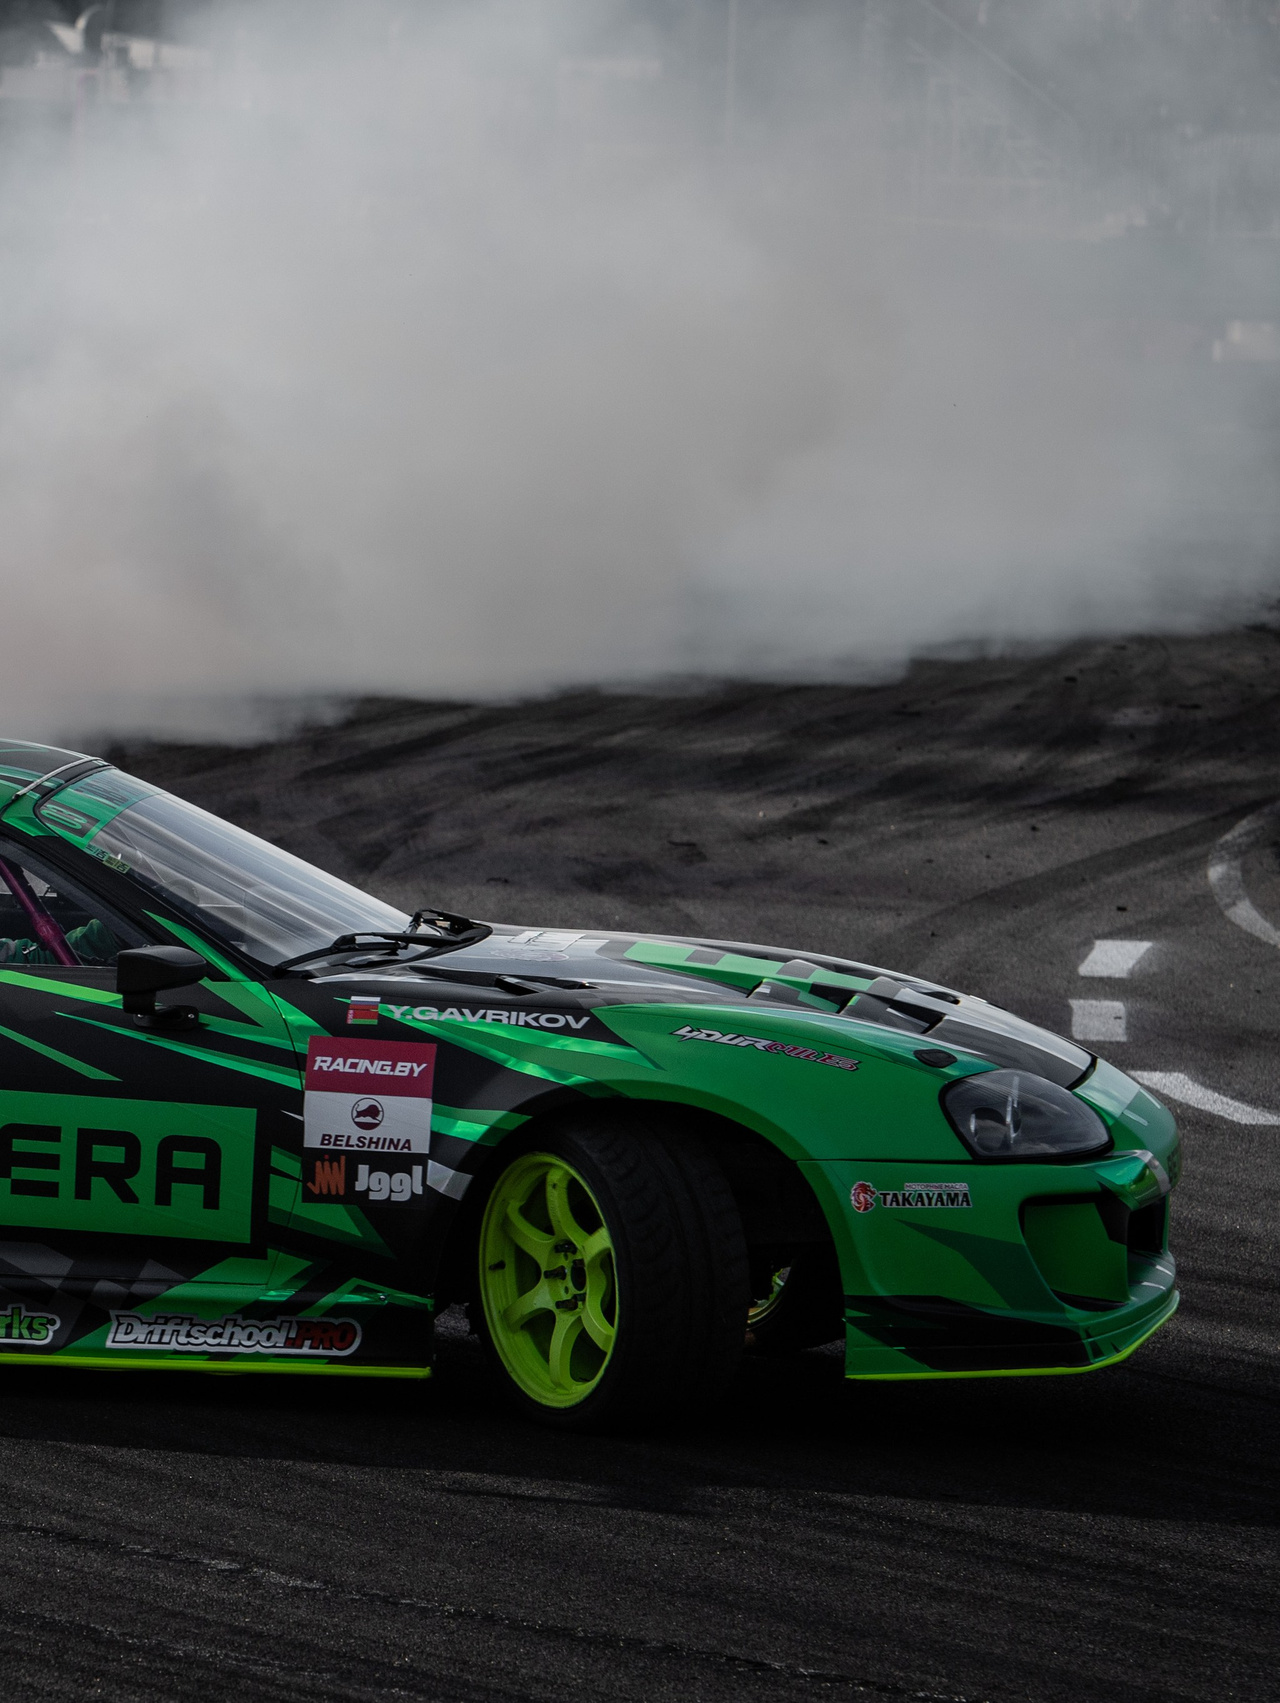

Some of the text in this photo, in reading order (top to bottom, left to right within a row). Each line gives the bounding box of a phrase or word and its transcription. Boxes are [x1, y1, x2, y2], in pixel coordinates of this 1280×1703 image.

[388, 1004, 591, 1030] Y.GAVRIKOV
[313, 1055, 427, 1078] RACING.BY
[320, 1133, 412, 1152] BELSHINA
[355, 1164, 423, 1201] Jggl
[879, 1192, 972, 1207] TAKAYAMA
